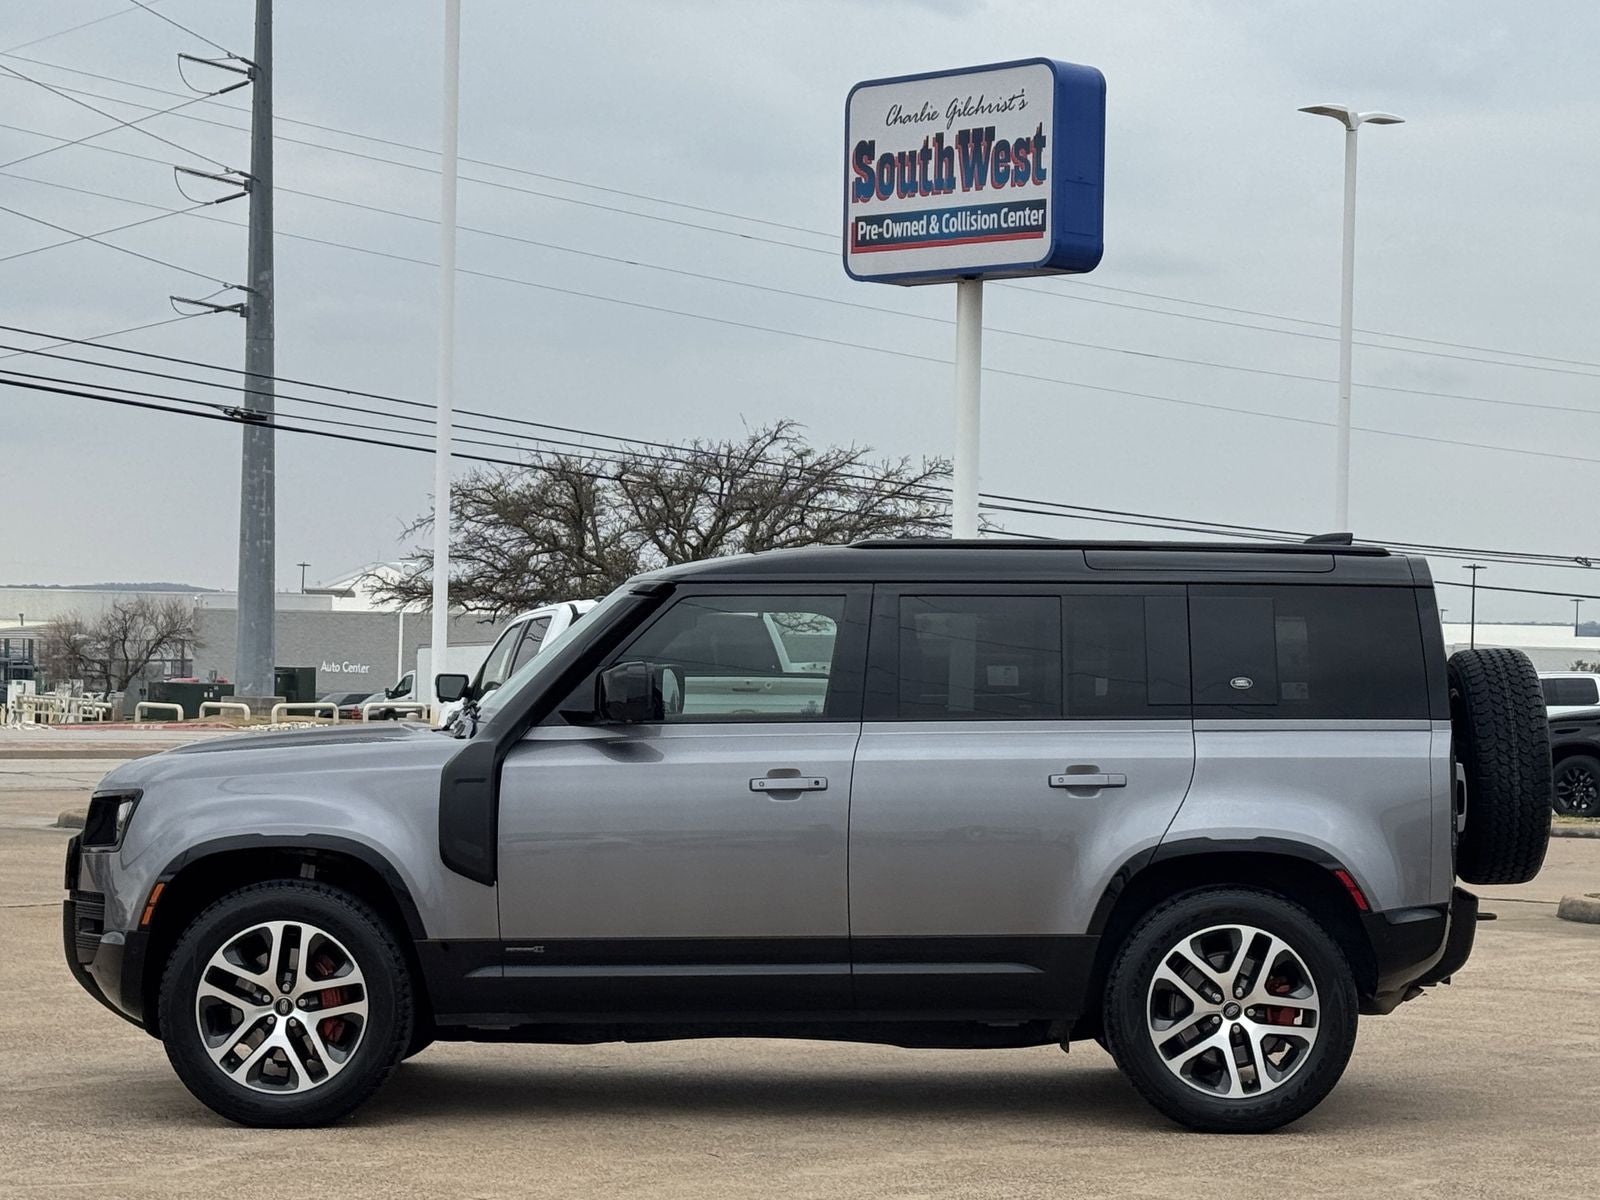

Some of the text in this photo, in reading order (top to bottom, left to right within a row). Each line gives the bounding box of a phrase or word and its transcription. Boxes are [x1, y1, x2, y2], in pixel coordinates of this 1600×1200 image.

[886, 89, 1029, 130] Charlie Gilchrist's
[857, 206, 1044, 241] Pre-Owned & Collision Center
[320, 660, 370, 674] Auto Center
